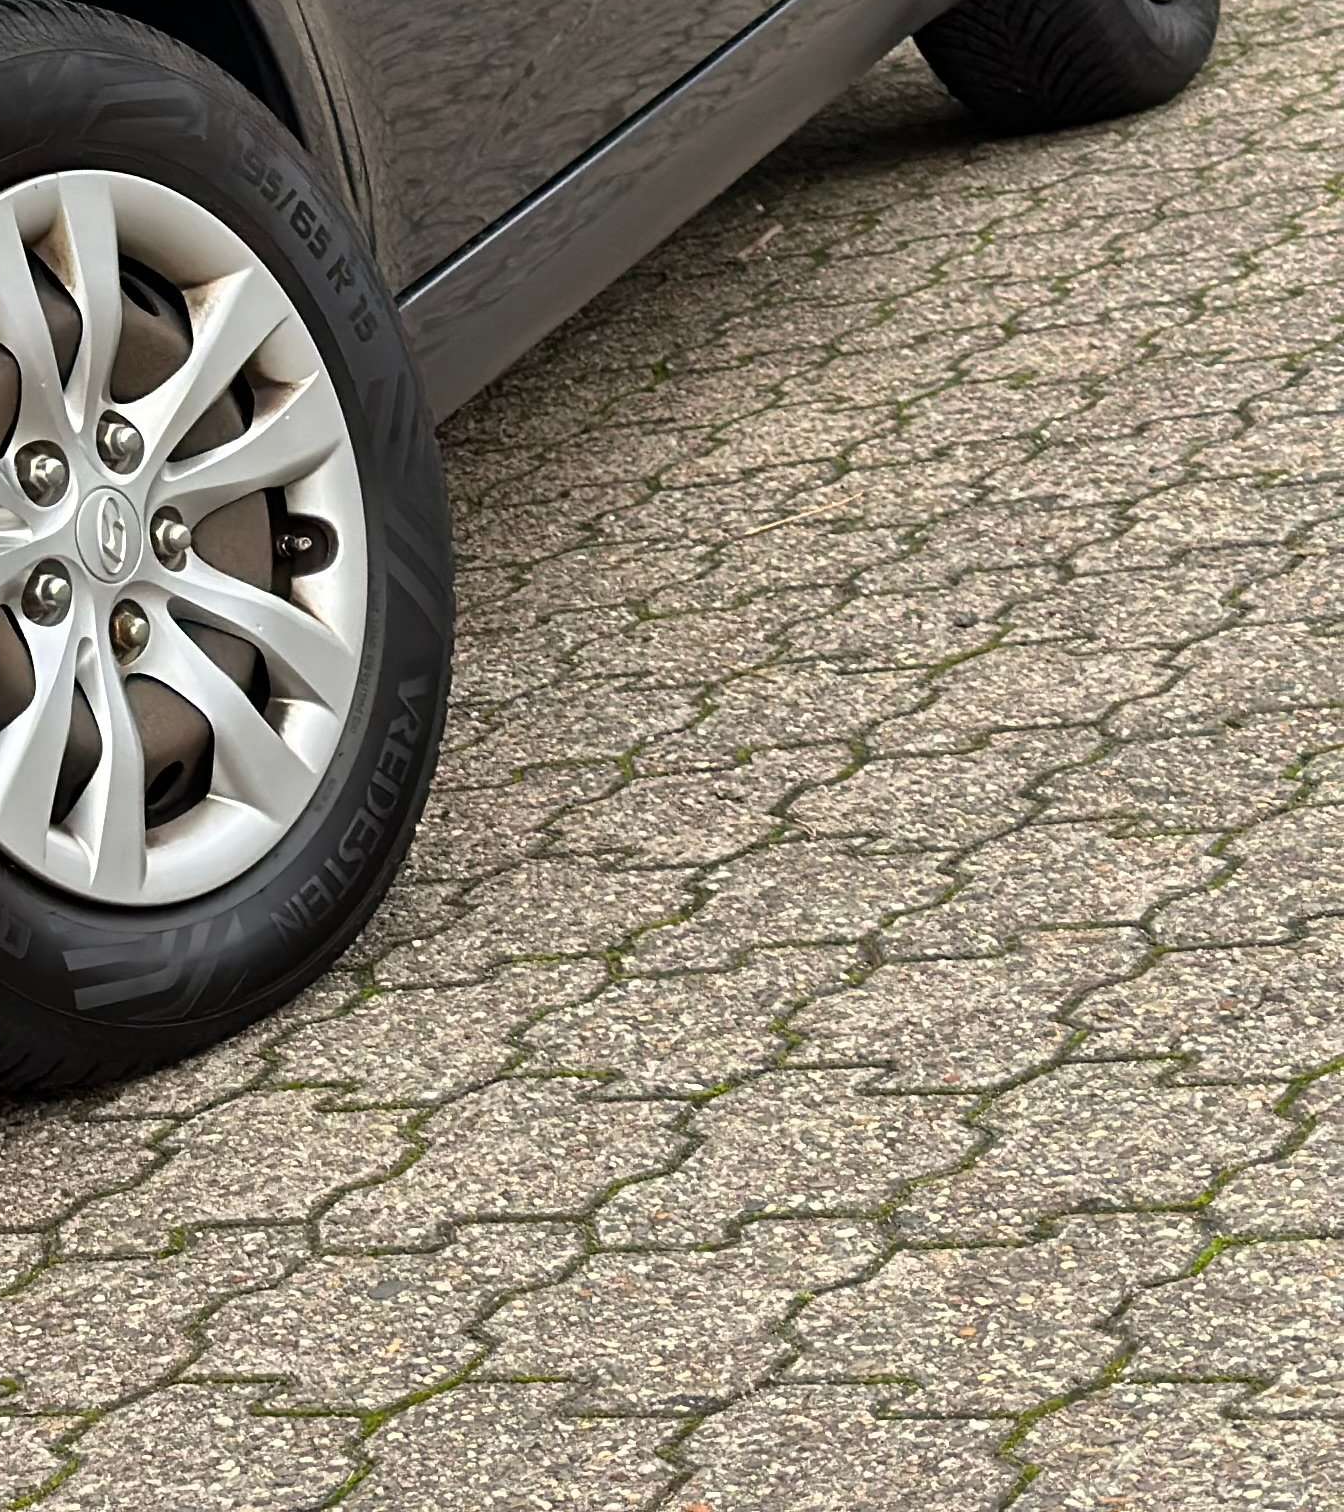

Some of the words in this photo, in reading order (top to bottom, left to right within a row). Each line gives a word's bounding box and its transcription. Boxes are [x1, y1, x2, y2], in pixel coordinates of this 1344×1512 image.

[239, 149, 332, 261] 95/65
[325, 253, 355, 294] R
[269, 672, 433, 946] VREDESTEIN
